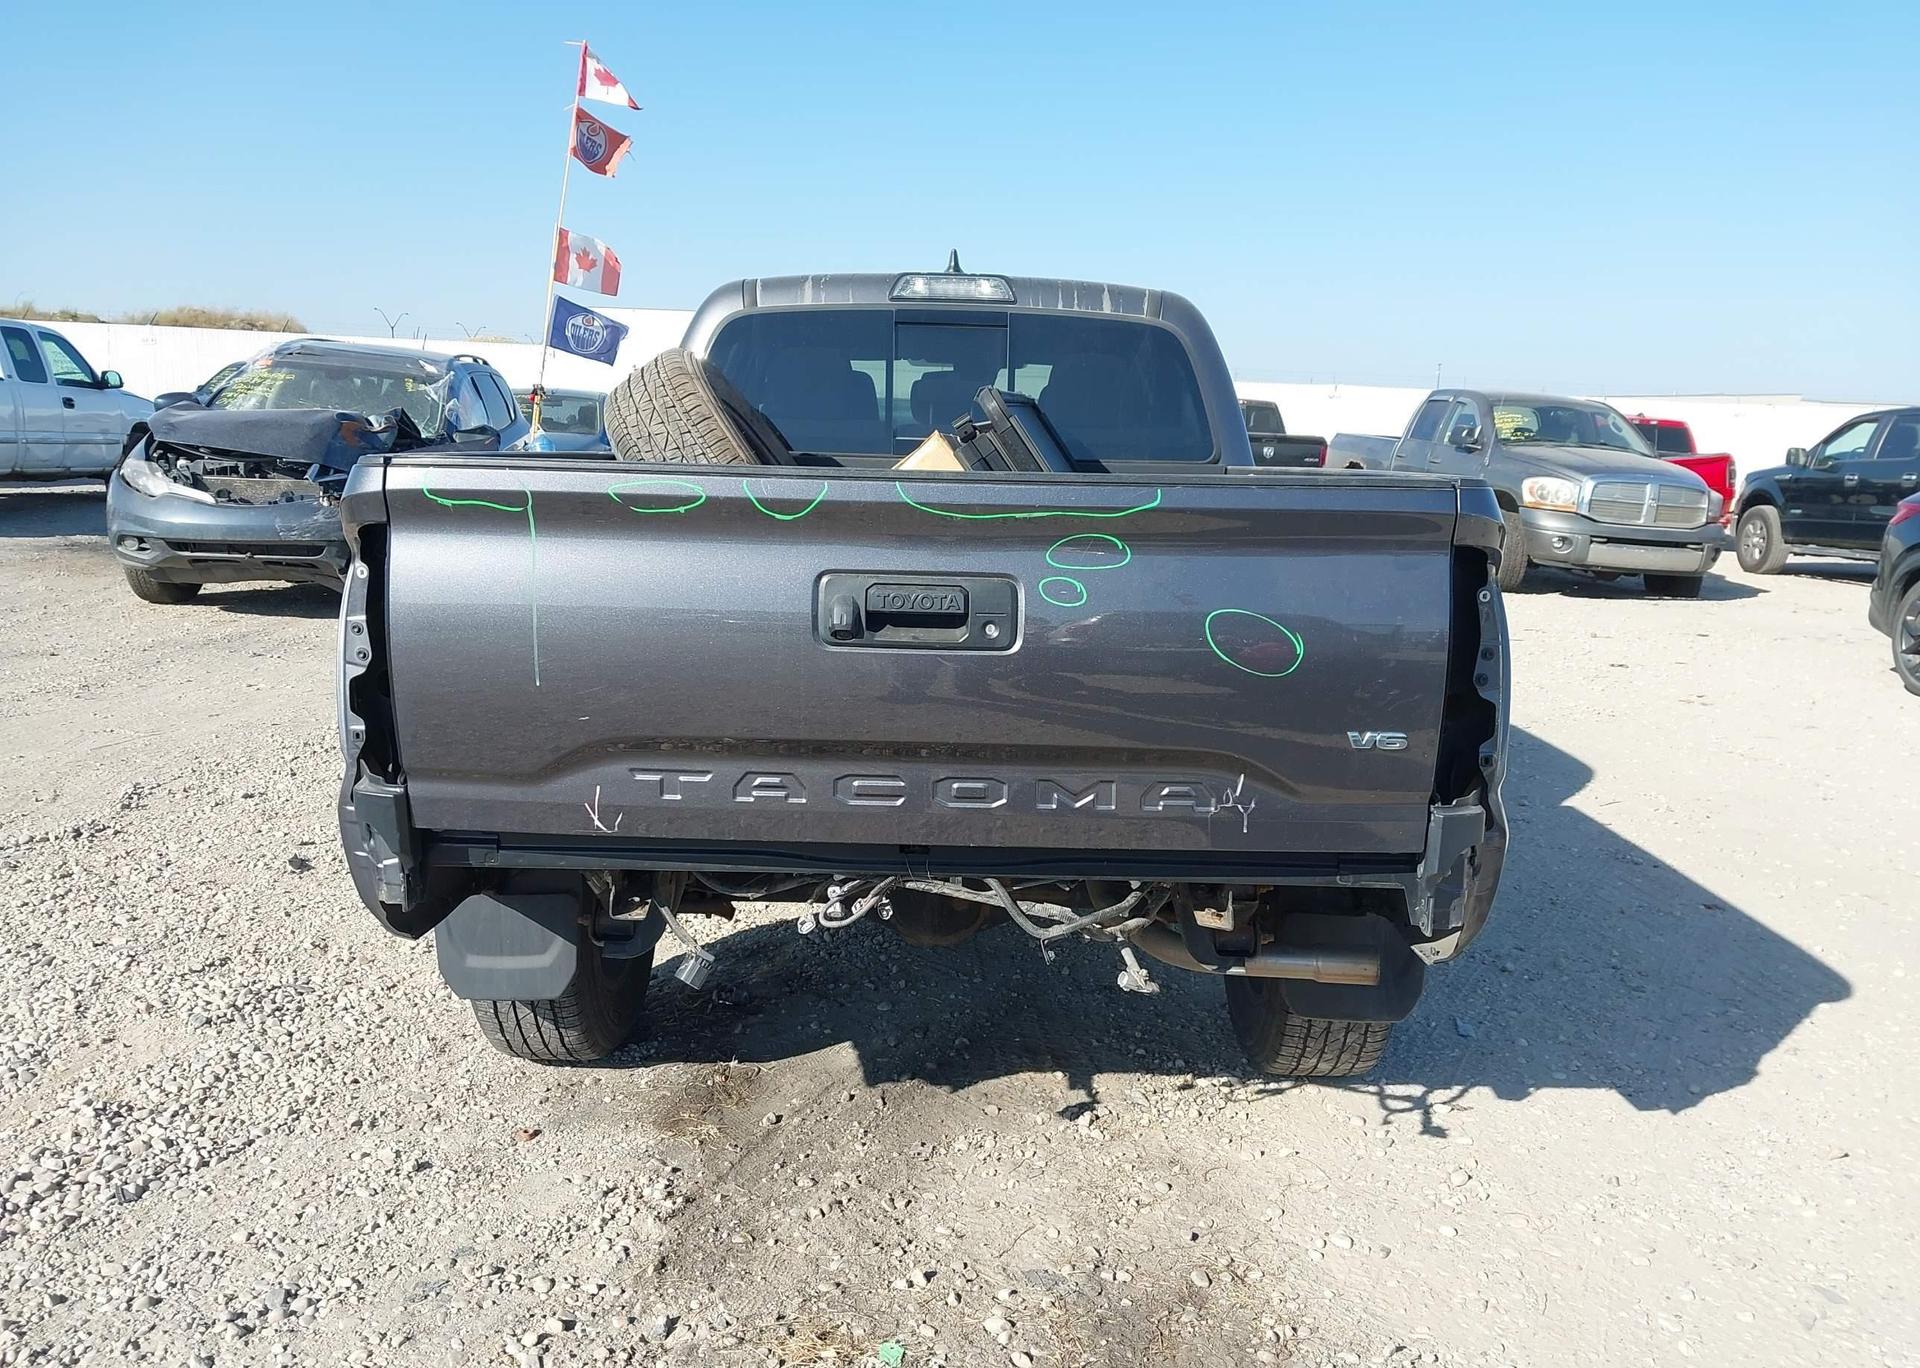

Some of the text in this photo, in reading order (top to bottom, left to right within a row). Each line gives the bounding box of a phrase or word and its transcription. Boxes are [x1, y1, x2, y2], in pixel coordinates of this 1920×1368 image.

[570, 323, 600, 346] OILERS
[876, 591, 962, 611] TOYOTA
[1346, 731, 1409, 750] V6
[632, 769, 1216, 813] TACOMA
